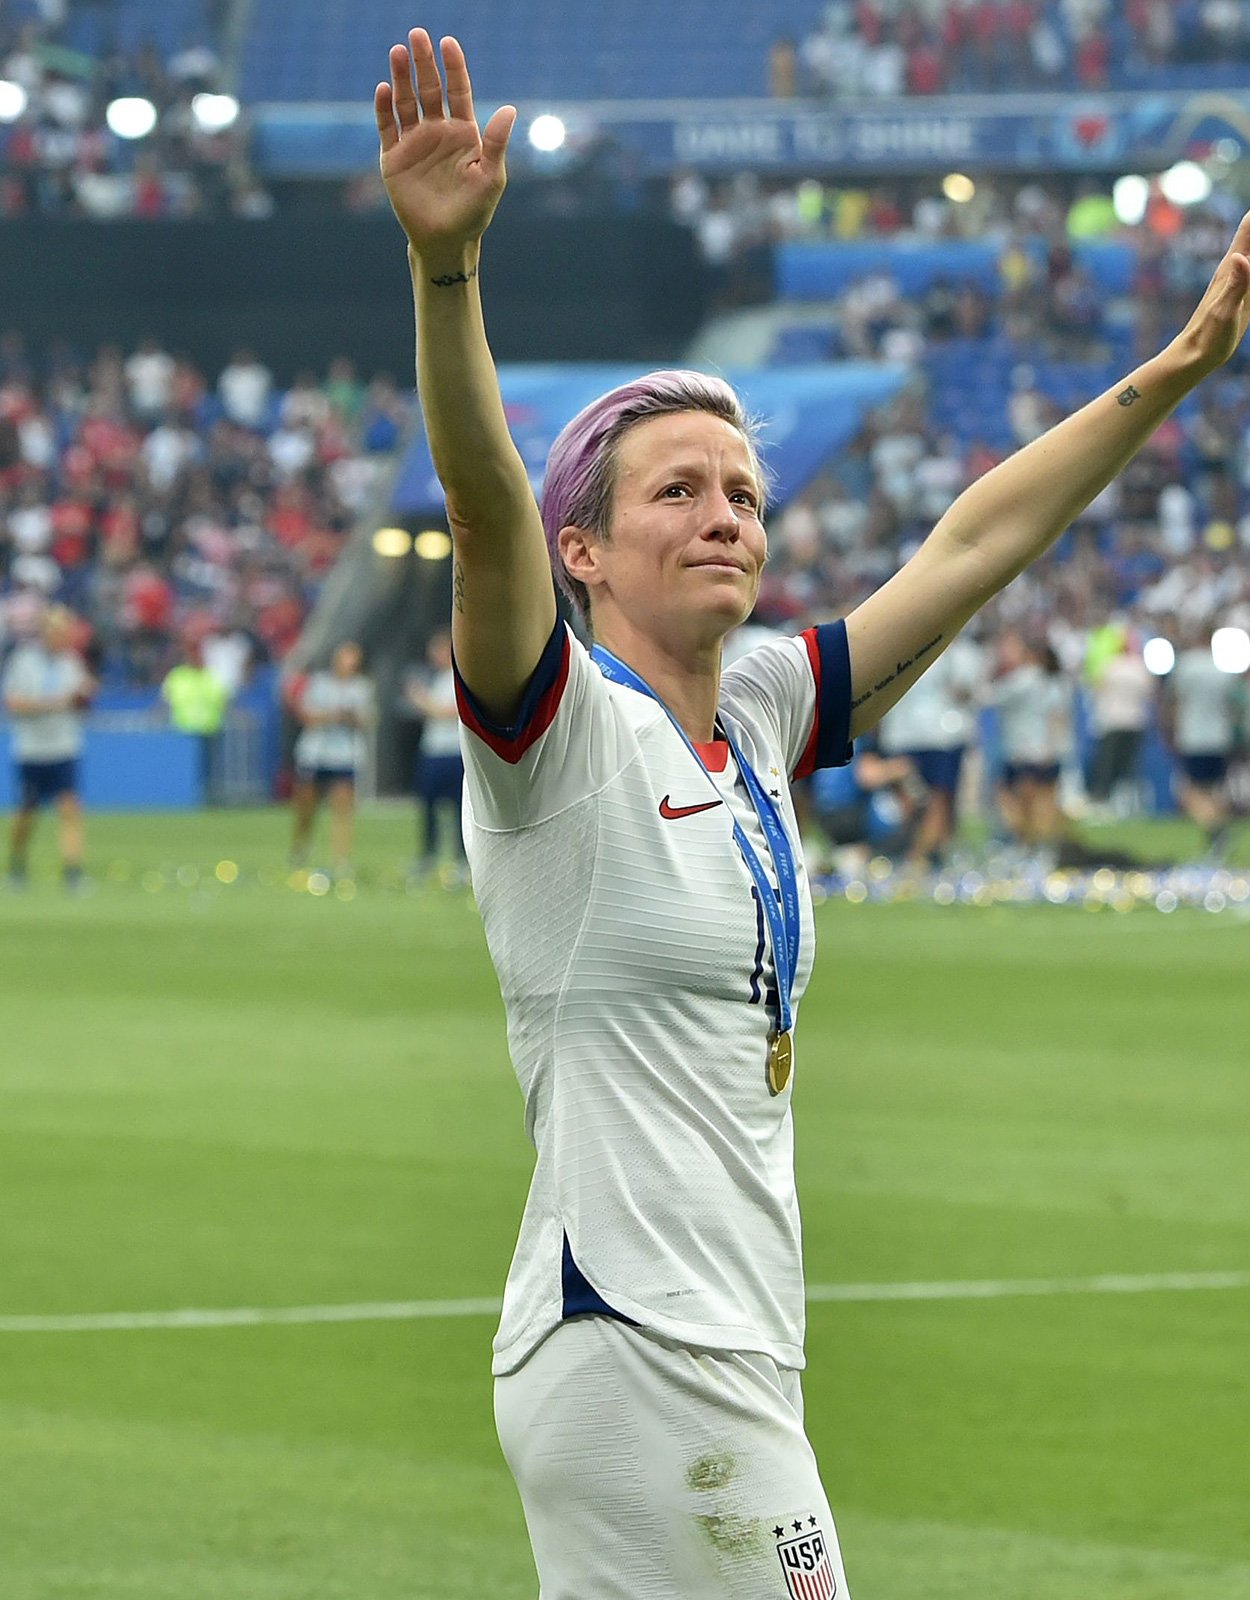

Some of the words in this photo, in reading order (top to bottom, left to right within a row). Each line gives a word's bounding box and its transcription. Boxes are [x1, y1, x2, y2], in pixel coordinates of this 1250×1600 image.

[766, 814, 779, 837] FIFA
[780, 852, 789, 876] FIFA
[787, 893, 795, 918] FIFA
[766, 894, 775, 919] FIFA
[783, 1537, 824, 1571] USA
